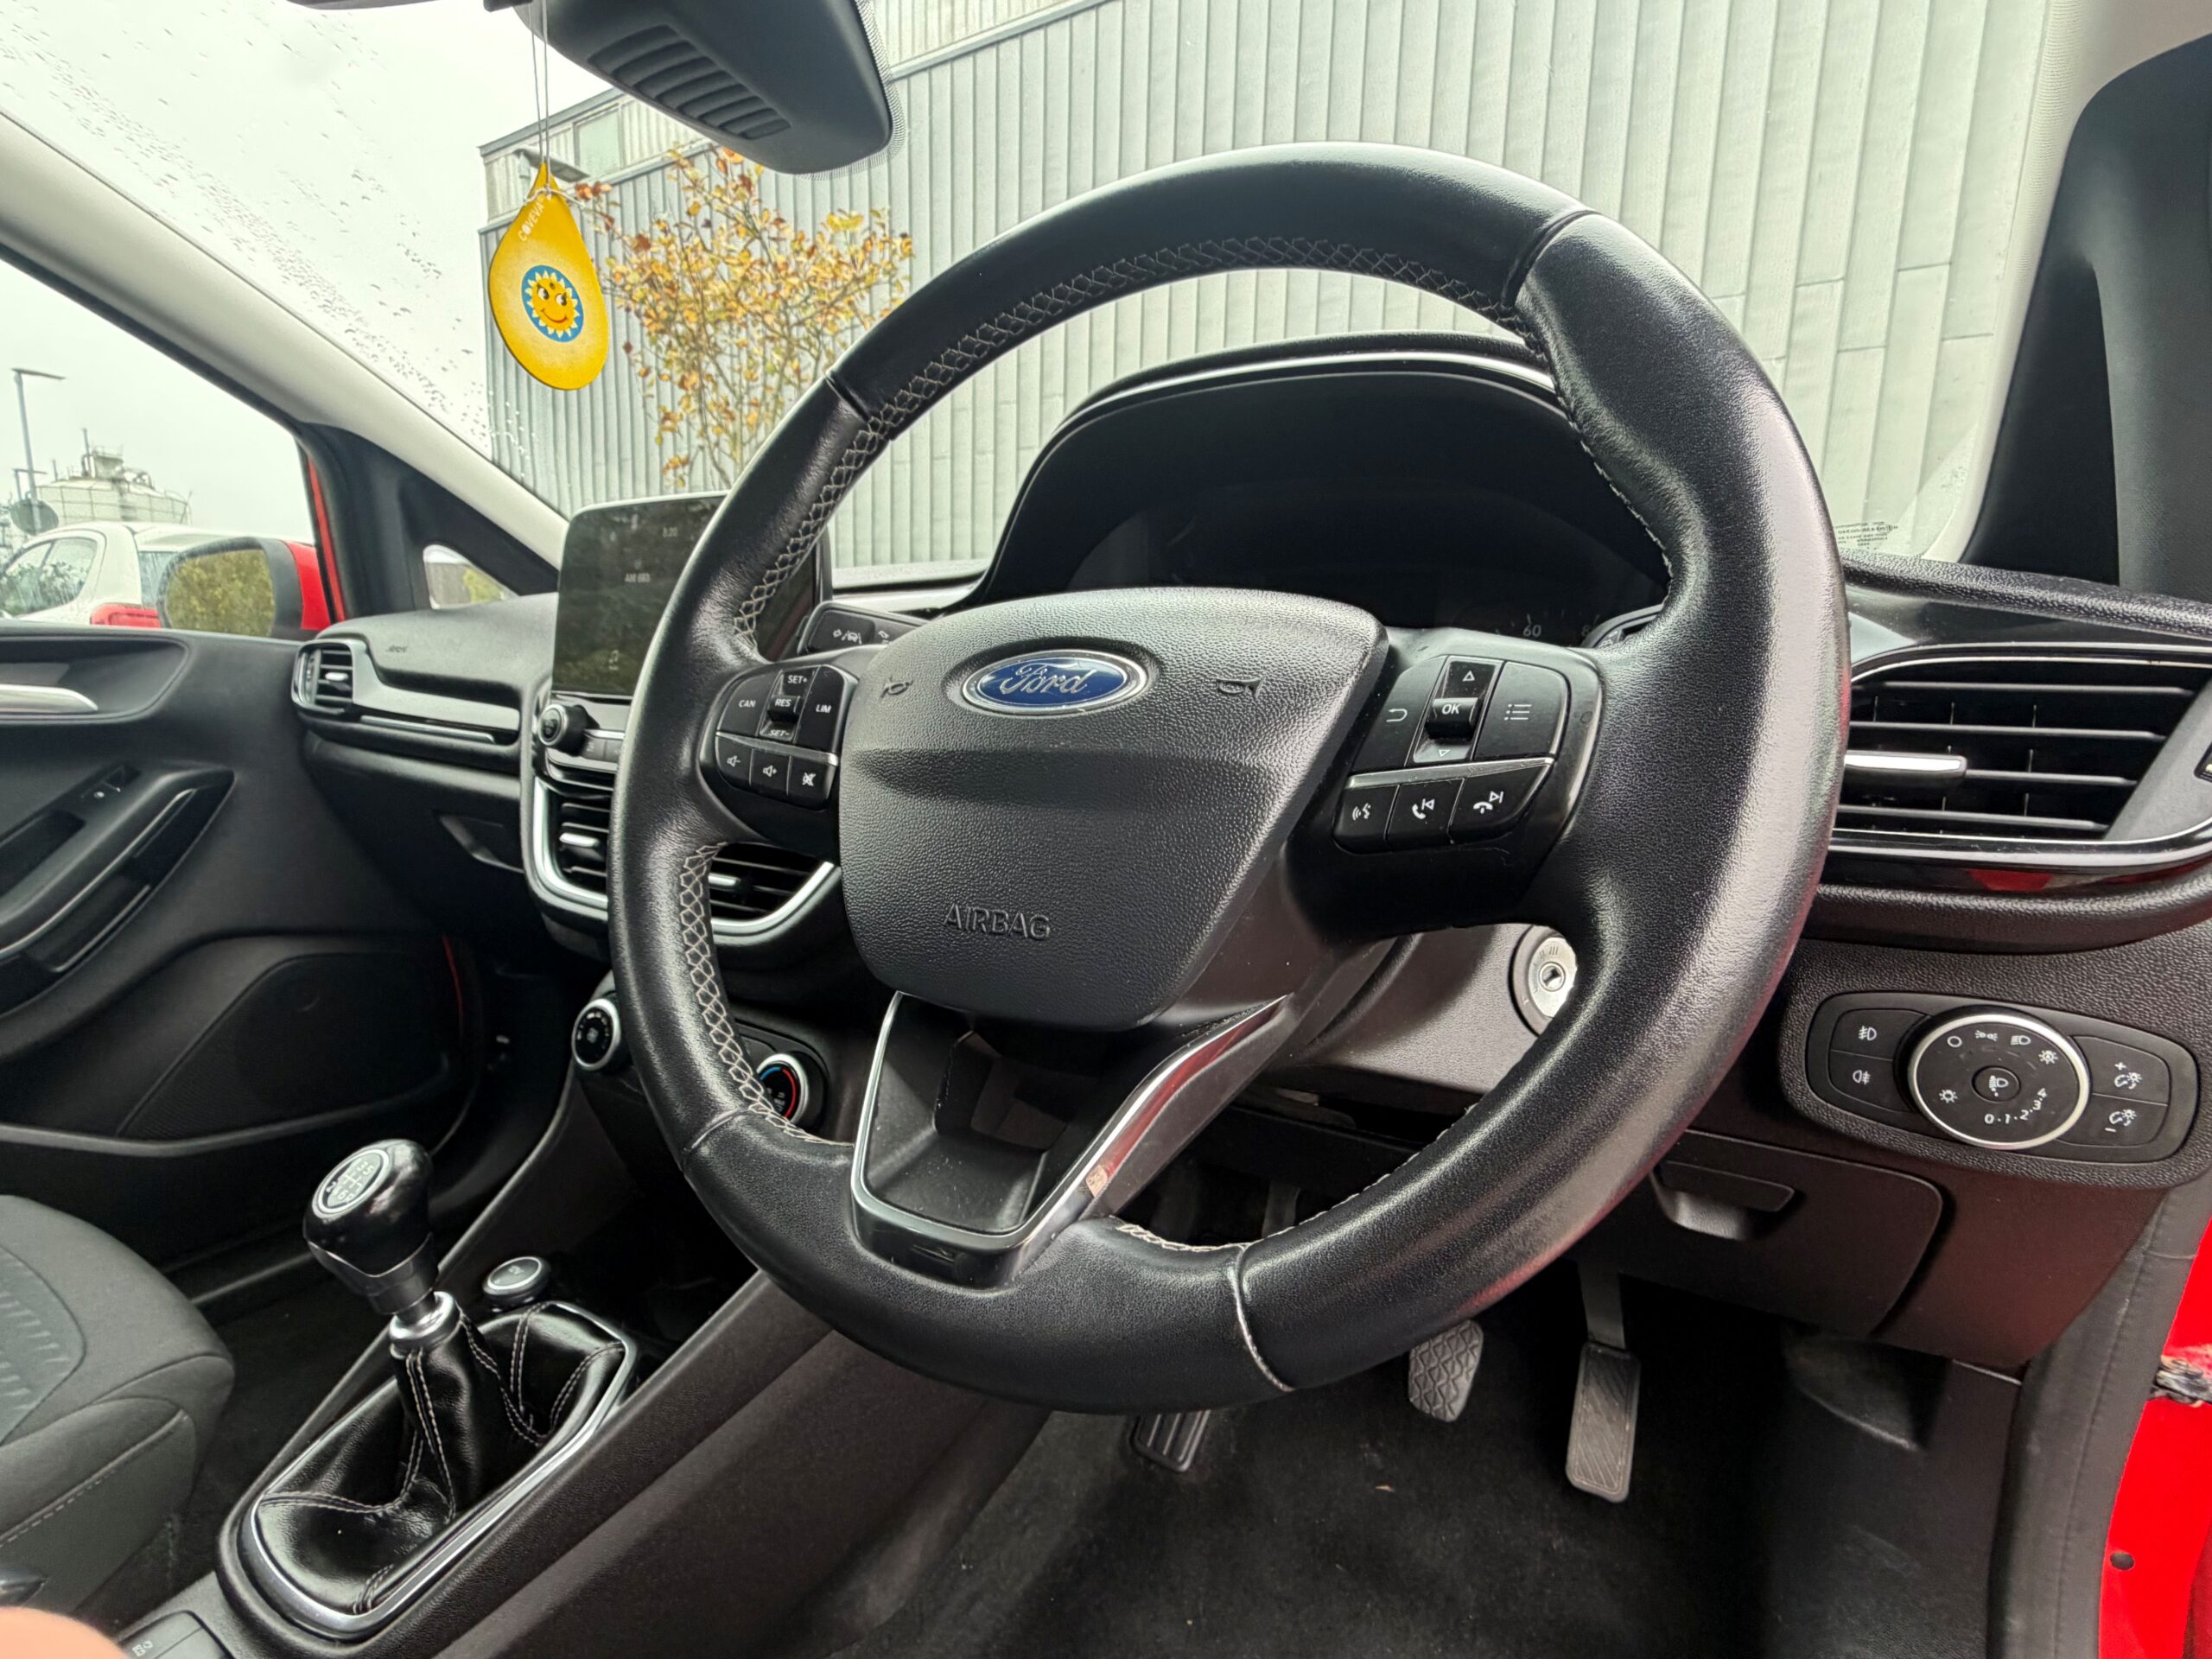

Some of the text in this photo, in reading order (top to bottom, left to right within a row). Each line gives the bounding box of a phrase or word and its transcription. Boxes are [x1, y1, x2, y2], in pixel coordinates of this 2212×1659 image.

[1522, 624, 1542, 638] 60
[787, 674, 808, 684] SET+
[999, 662, 1097, 695] Ford
[738, 699, 756, 709] CAN
[774, 698, 792, 708] RES
[815, 704, 832, 714] LIM
[1441, 703, 1462, 715] OK
[942, 903, 1052, 940] AIRBAG
[338, 1189, 349, 1200] 6
